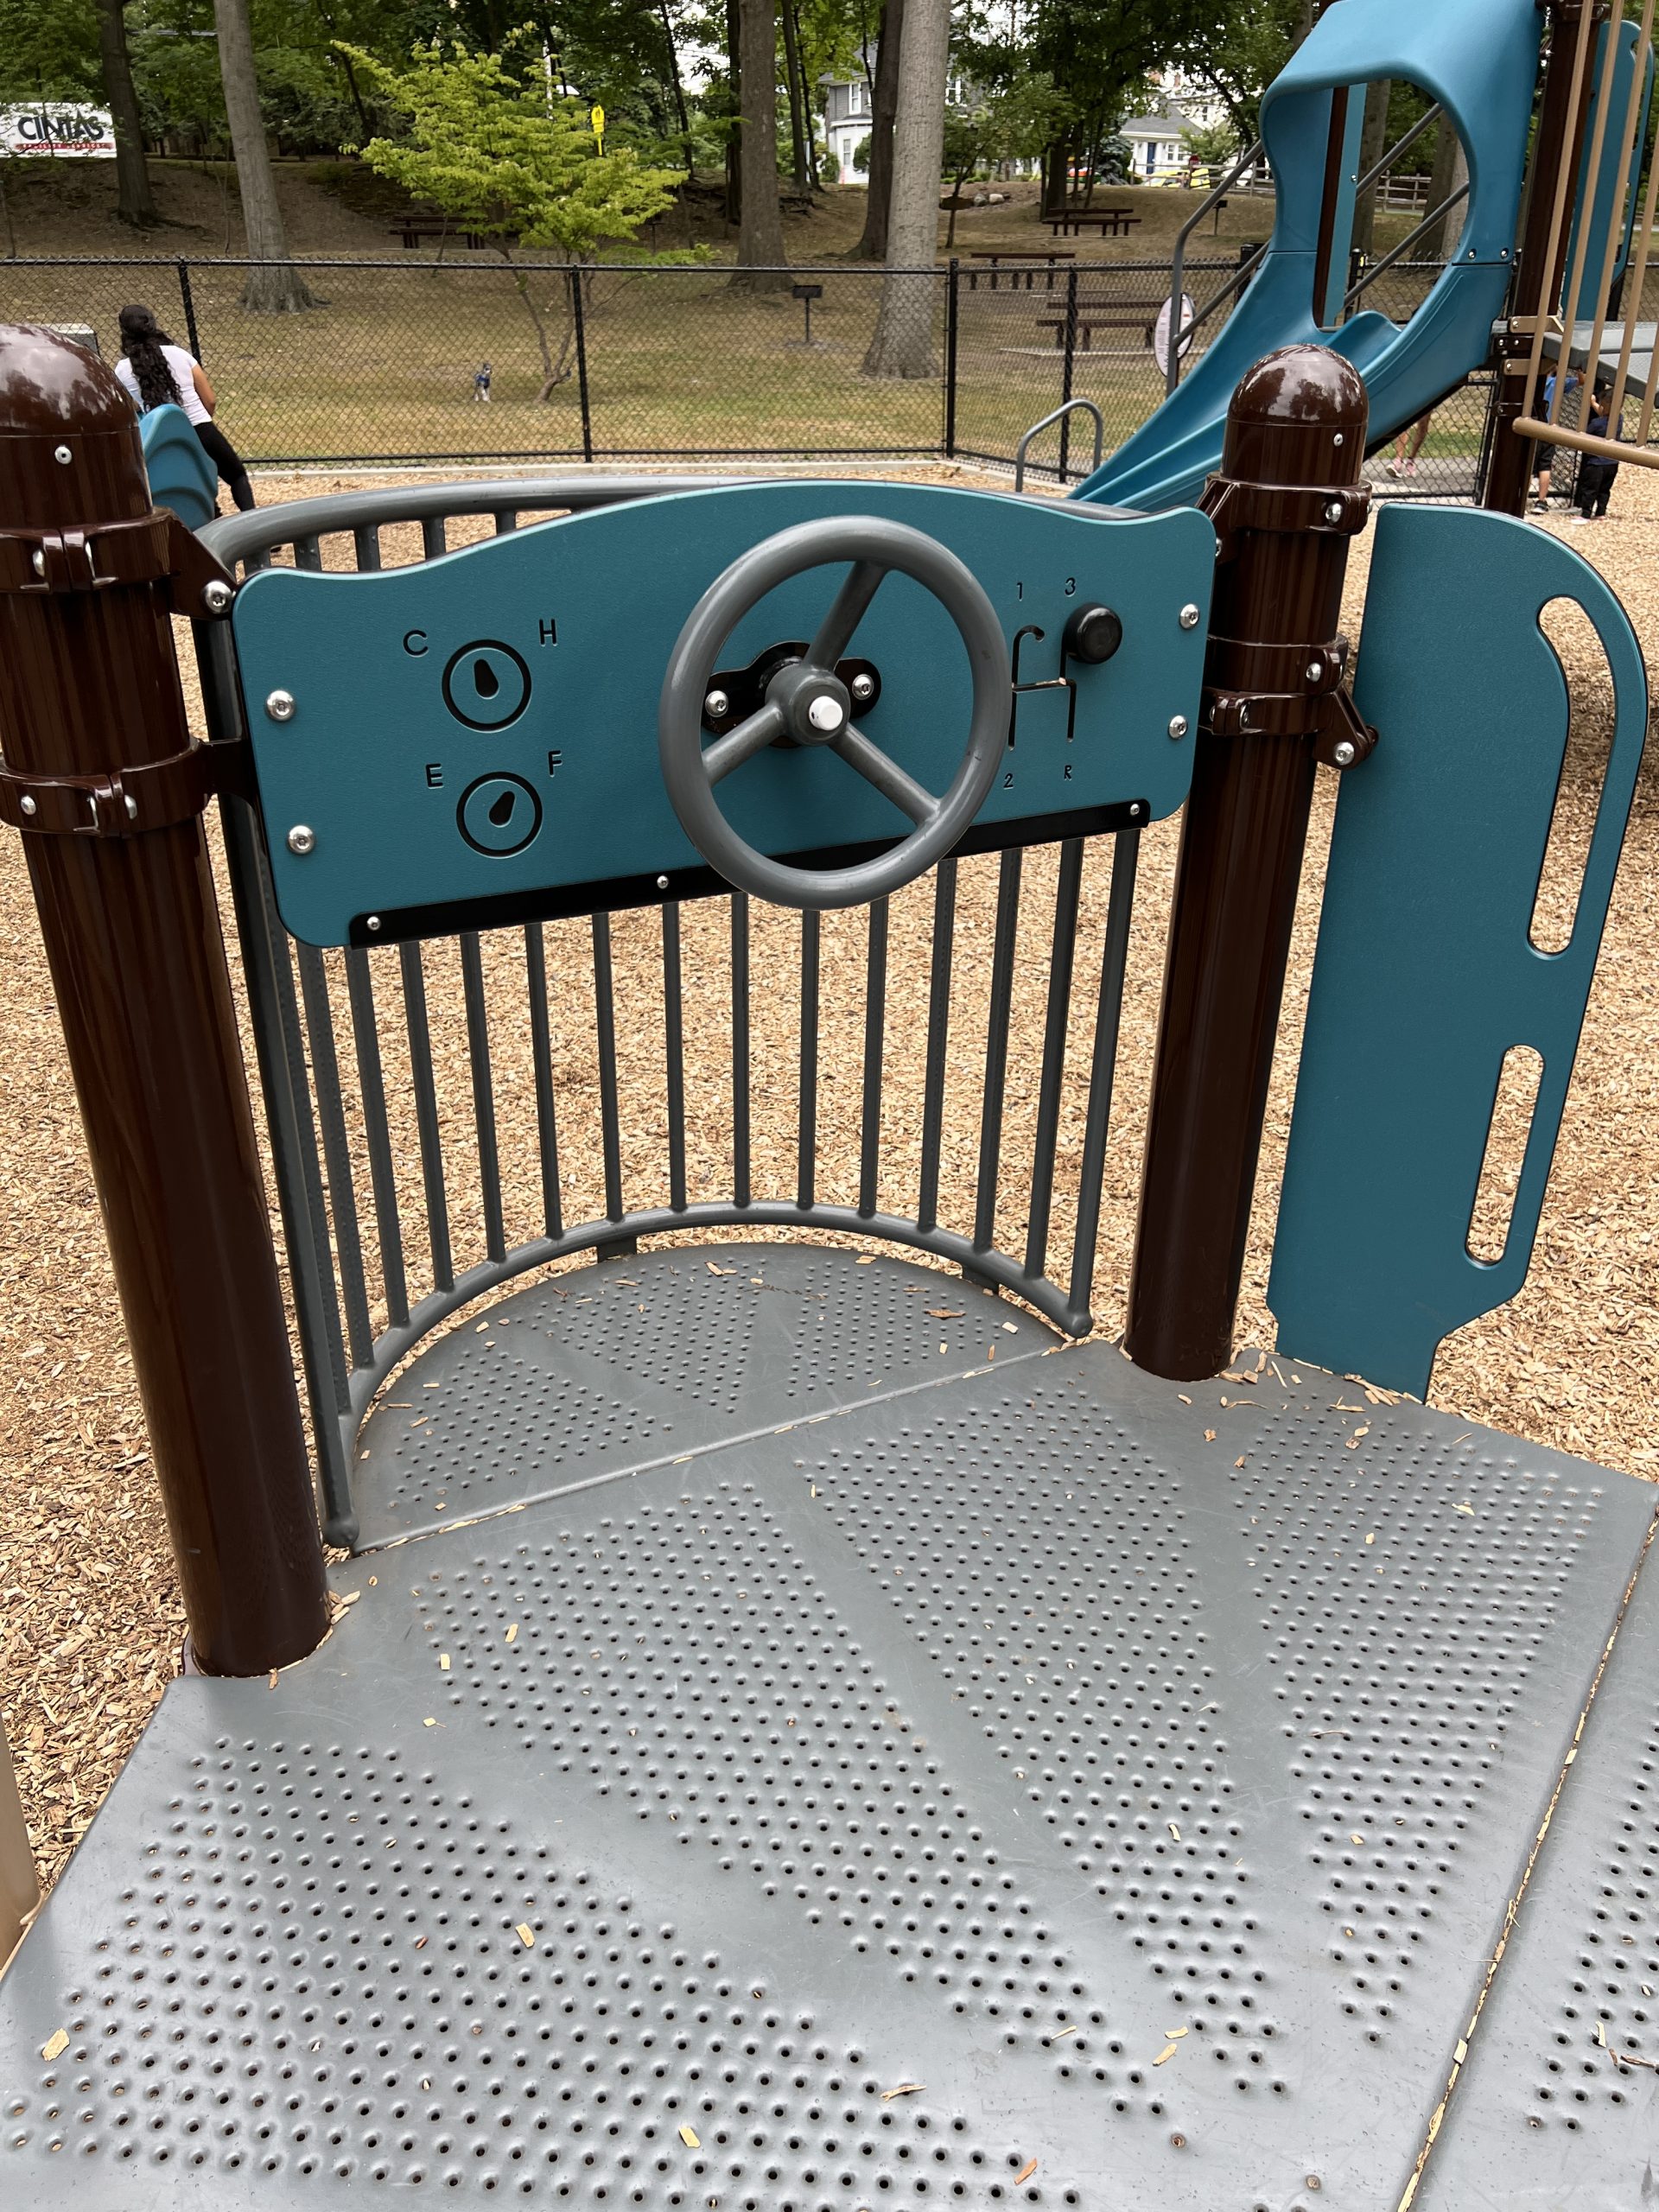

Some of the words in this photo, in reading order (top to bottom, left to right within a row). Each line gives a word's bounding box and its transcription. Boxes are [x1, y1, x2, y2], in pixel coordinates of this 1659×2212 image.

[17, 110, 104, 141] CINTAS
[1016, 582, 1024, 601] 1
[1064, 577, 1077, 596] 3
[403, 629, 429, 658] C
[538, 618, 558, 646] H
[425, 763, 444, 790] E
[548, 750, 563, 778] F
[1063, 765, 1072, 780] R
[1002, 772, 1014, 789] 2
